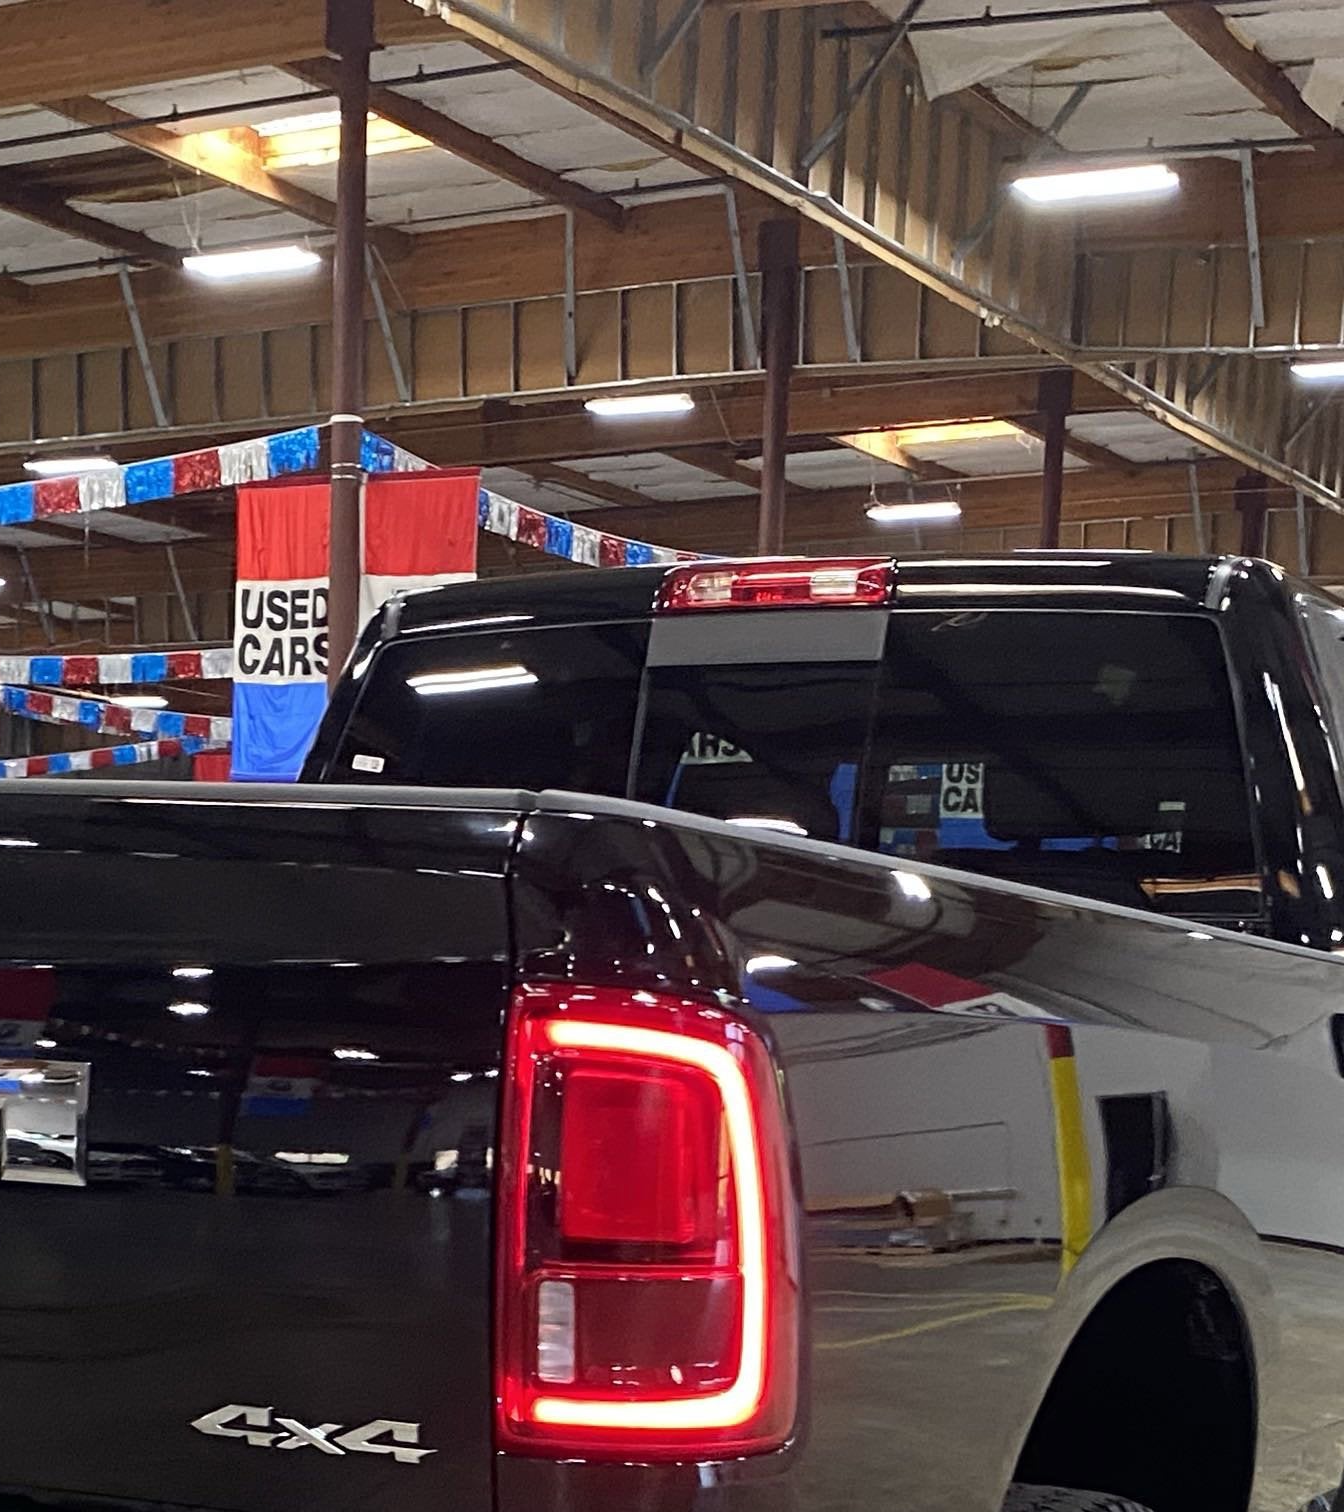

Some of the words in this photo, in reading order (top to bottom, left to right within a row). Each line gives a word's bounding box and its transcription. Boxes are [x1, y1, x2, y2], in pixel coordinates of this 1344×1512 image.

[241, 588, 329, 631] USED
[238, 633, 329, 677] CARS
[190, 1404, 439, 1464] 4x4
